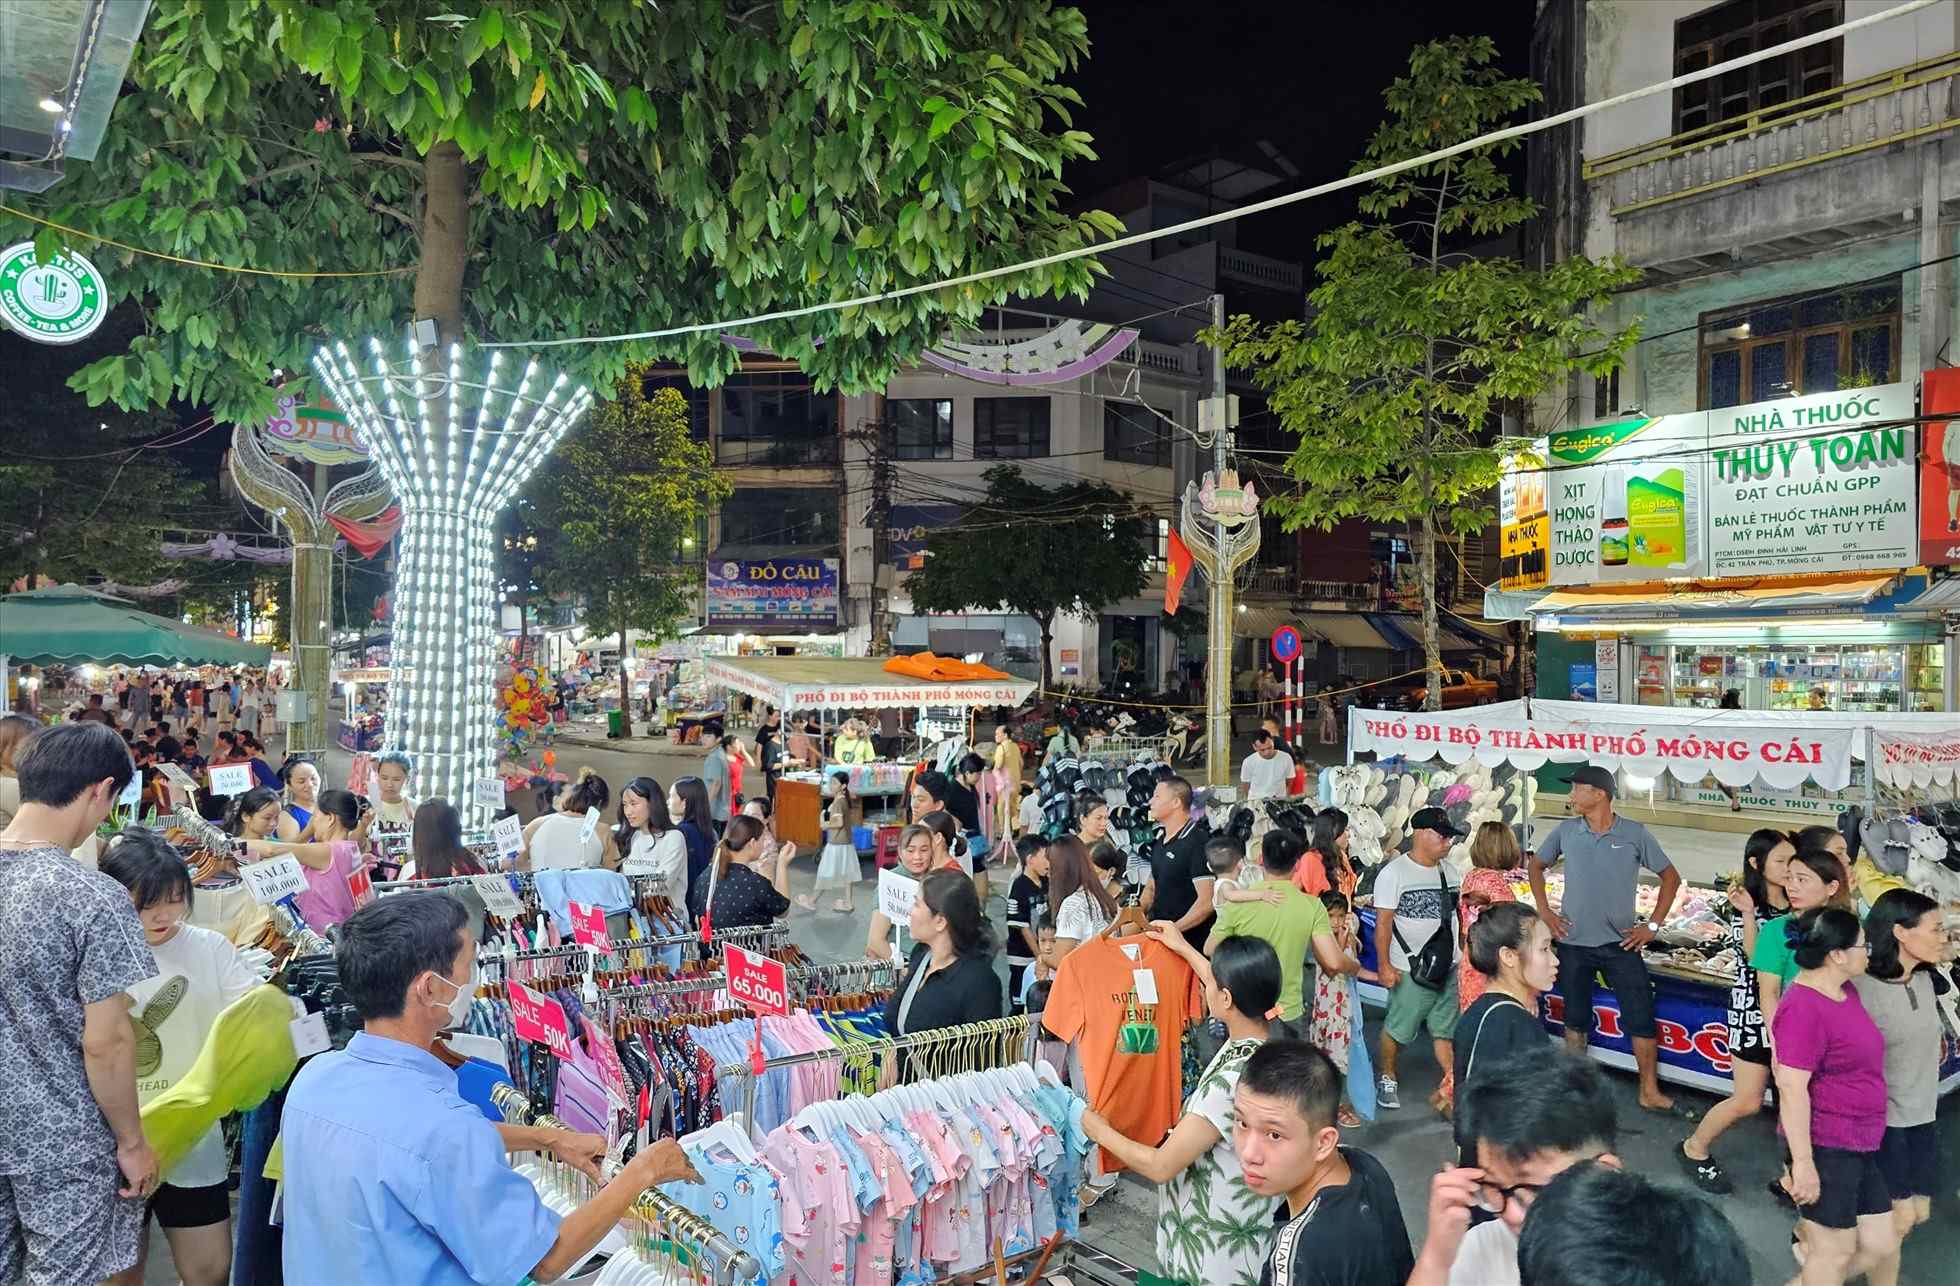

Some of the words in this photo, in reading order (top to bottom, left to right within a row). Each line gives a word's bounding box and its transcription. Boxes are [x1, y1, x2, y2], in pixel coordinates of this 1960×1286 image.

[19, 252, 86, 279] KTUS
[1735, 408, 1784, 433] NHÀ
[1793, 394, 1880, 425] THUỐC
[1564, 482, 1586, 502] XỊT
[1736, 486, 1768, 503] ĐẠT
[1776, 476, 1838, 497] CHUẨN
[1844, 476, 1880, 491] GPP
[1555, 504, 1595, 524] HỌNG
[1760, 507, 1806, 523] THUỐC
[1810, 504, 1859, 519] THÀNH
[1555, 524, 1594, 544] THẢO
[1733, 528, 1752, 541] MỸ
[1756, 524, 1794, 539] PHẨM
[1833, 522, 1852, 533] TƯ
[1856, 521, 1864, 532] Y
[1868, 515, 1885, 531] TẾ
[1555, 549, 1595, 568] DƯỢC
[750, 562, 777, 580] ĐỒ
[782, 564, 820, 580] CÂU
[795, 688, 825, 703] PHỐ
[830, 691, 845, 702] ĐI
[851, 689, 869, 704] BỘ
[873, 687, 920, 702] THÀNH
[925, 685, 950, 700] PHỐ
[955, 686, 991, 700] MÓNG
[995, 686, 1016, 700] CÁI
[1366, 716, 1408, 739] PHỐ
[1416, 723, 1441, 741] ĐI
[1448, 722, 1481, 750] BỘ
[1489, 726, 1588, 750] THÀNH
[1592, 728, 1648, 756] PHỐ
[1657, 734, 1750, 761] MÓNG
[1760, 736, 1823, 763] CÁI
[478, 782, 499, 792] SALE
[253, 861, 292, 882] SALE
[260, 878, 300, 897] 100.000
[572, 915, 590, 933] SALE
[591, 930, 609, 949] 50K
[744, 967, 768, 984] SALE
[733, 976, 782, 1008] 65.000
[514, 999, 541, 1026] SALE
[544, 1023, 571, 1057] 50K
